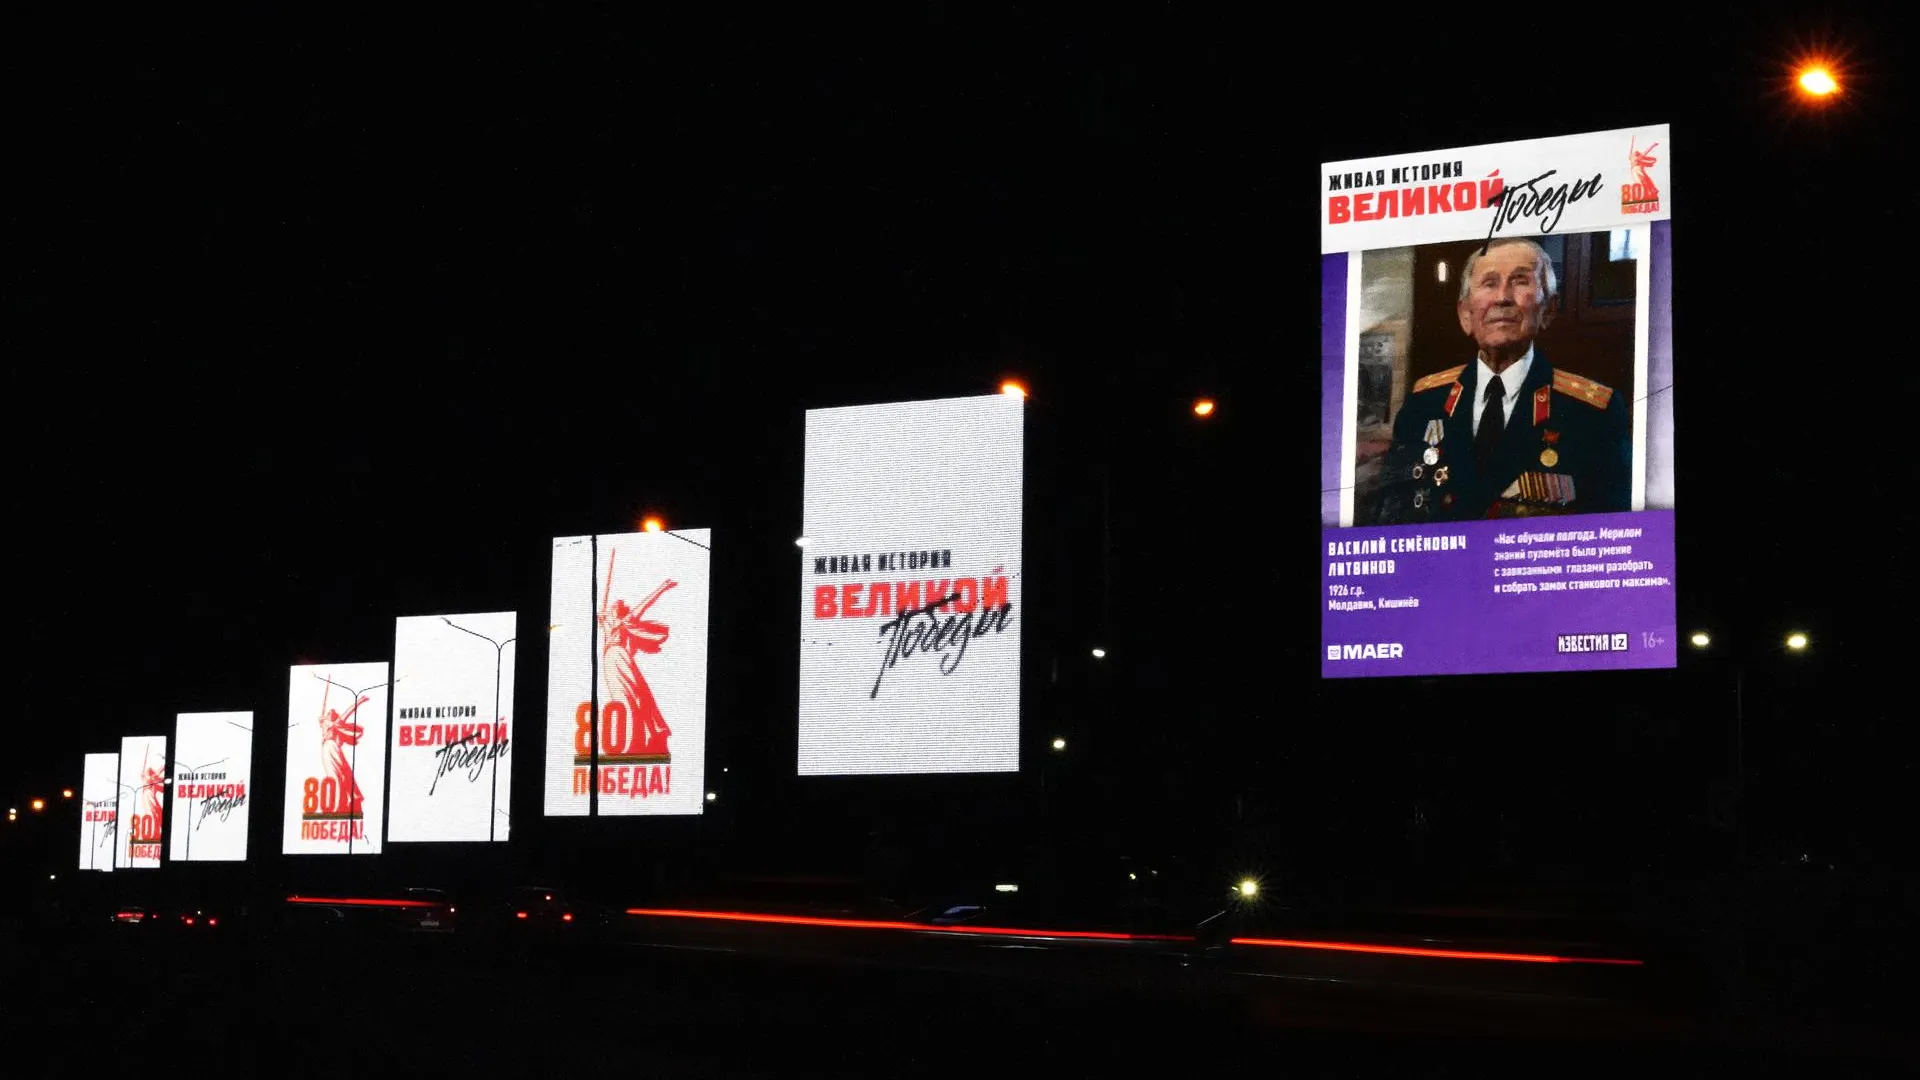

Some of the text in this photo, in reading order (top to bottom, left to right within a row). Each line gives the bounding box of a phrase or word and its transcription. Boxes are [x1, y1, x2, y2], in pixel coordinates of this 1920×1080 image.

[1329, 161, 1463, 191] ЖИВАЯ ИСТОРИЯ
[1328, 169, 1504, 225] ВЕЛИКОЙ
[1621, 183, 1643, 203] 80
[1481, 170, 1604, 256] Победы
[1328, 535, 1467, 556] ВАСИЛИЙ СЕМЁНОВИЧ
[1494, 528, 1642, 546] «Нас обучали полгода. Мерилом
[814, 549, 951, 574] ЖИВАЯ ИСТОРИЯ
[1494, 545, 1632, 561] знаний пулемёта было умение
[1328, 560, 1396, 577] ЛИТВИНОВ
[1494, 560, 1654, 577] с завязанными глазами разобрать
[814, 566, 1009, 620] ВЕЛИКОЙ
[1328, 585, 1348, 597] 1926
[1494, 585, 1500, 593] и
[1501, 581, 1538, 594] собрать
[1539, 581, 1567, 592] замок
[1568, 579, 1620, 591] станкового
[1328, 597, 1420, 612] Молдавия, Кишинёв
[870, 593, 1012, 699] Победы
[1558, 634, 1609, 652] ИЗВЕСТИЯ
[1642, 632, 1665, 649] 16+
[1343, 643, 1404, 660] MAER
[399, 705, 476, 719] ЖИВАЯ ИСТОРИЯ
[399, 716, 508, 746] ВЕЛИКОЙ
[429, 732, 510, 796] Победы
[201, 772, 227, 780] ИСТОРИЯ
[178, 781, 245, 798] ВЕЛИКОЙ
[303, 776, 336, 813] 80
[301, 820, 363, 842] ПОБЕДА!
